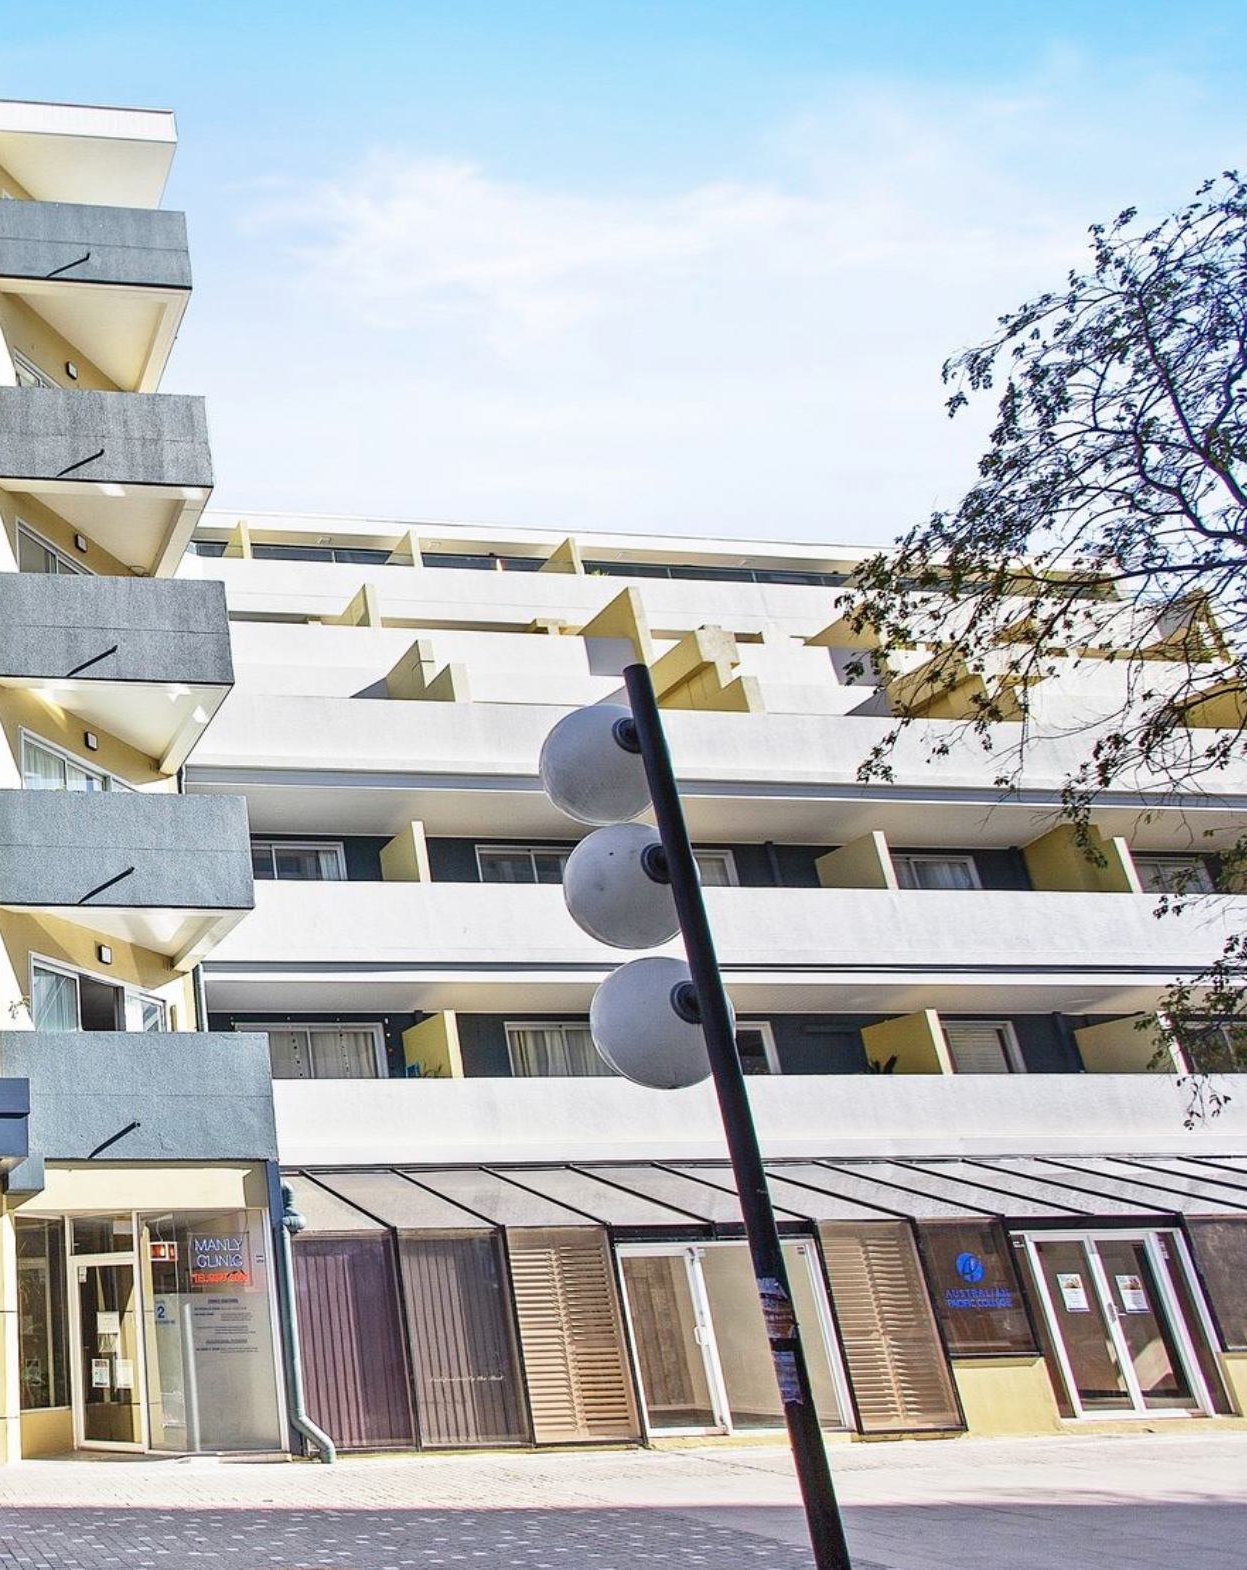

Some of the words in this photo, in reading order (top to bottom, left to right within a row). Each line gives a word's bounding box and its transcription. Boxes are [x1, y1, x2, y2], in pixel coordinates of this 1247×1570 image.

[194, 1238, 243, 1251] MANLY
[196, 1253, 243, 1268] CLINIC
[945, 1289, 1012, 1299] AUSTRALIAN
[156, 1306, 166, 1319] 2
